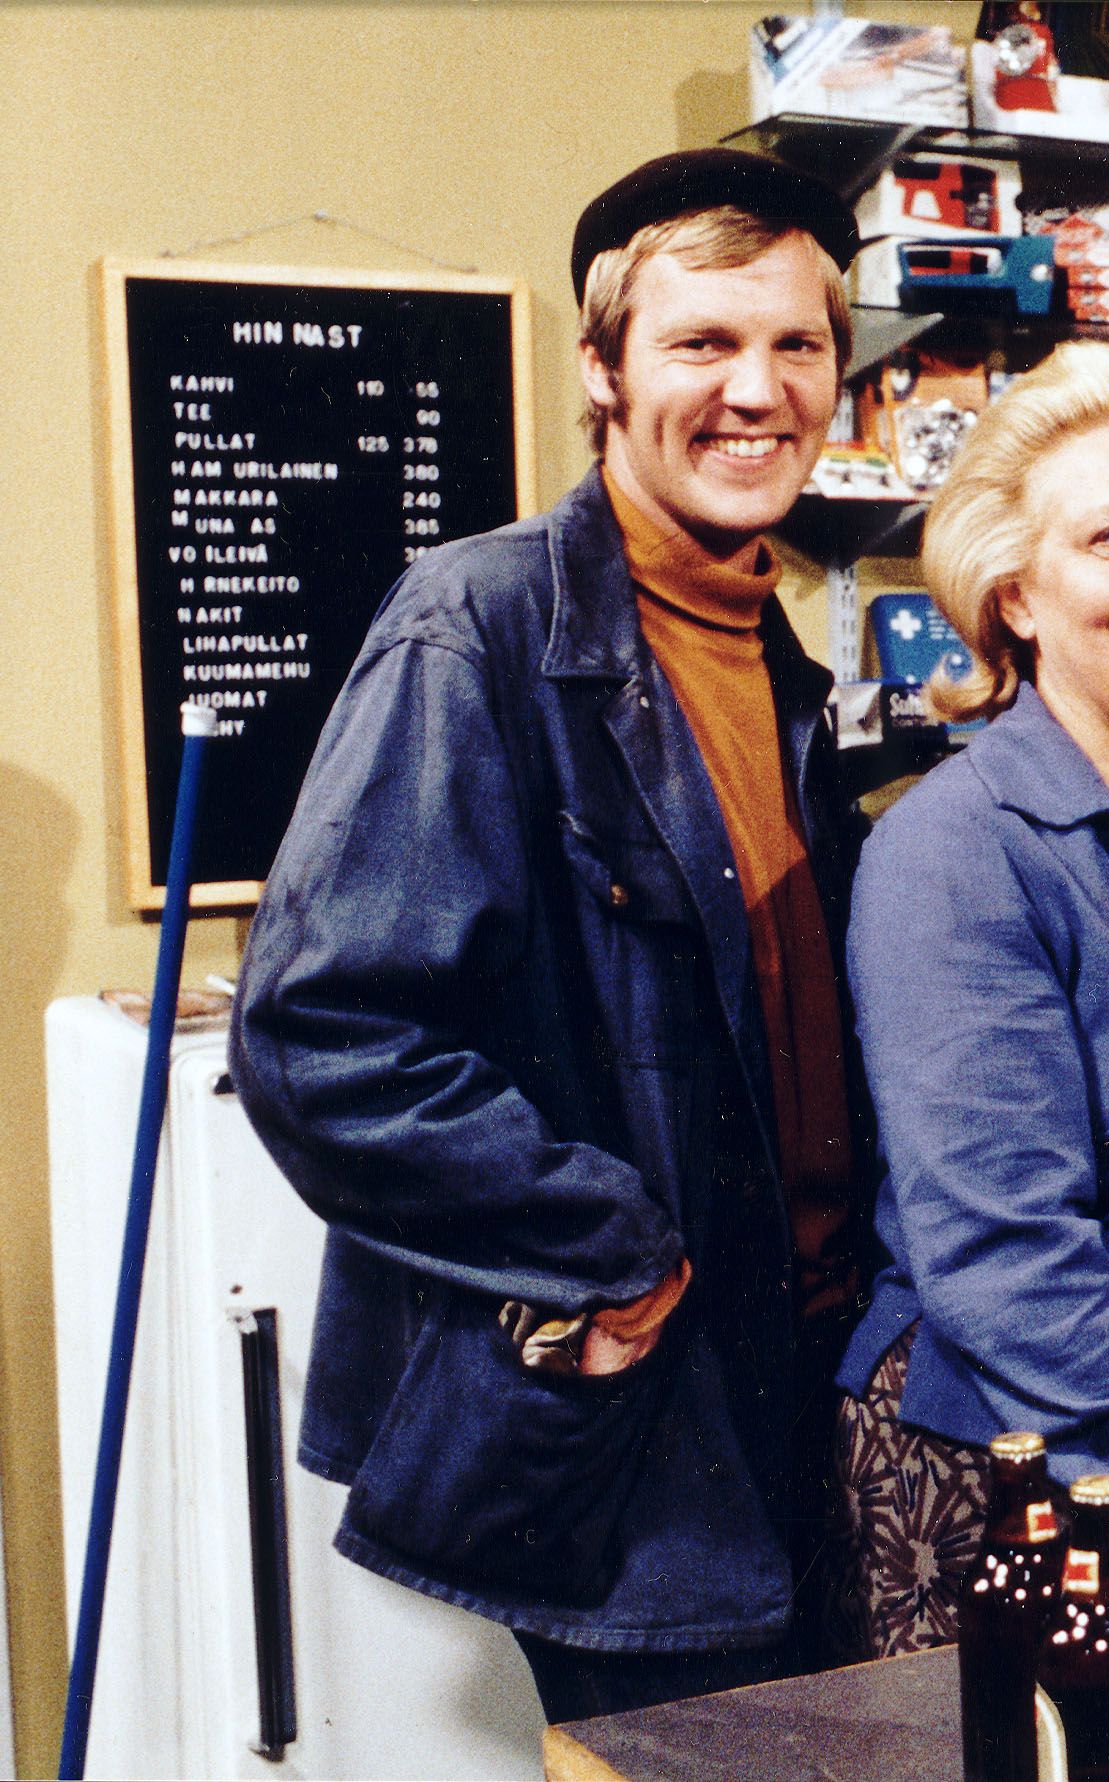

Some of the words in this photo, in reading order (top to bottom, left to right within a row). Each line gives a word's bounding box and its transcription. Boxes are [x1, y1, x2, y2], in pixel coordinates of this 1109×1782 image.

[170, 375, 234, 393] KAHVI
[173, 401, 212, 421] TEE
[175, 431, 256, 450] PULLAT
[402, 491, 441, 509] 240
[182, 633, 309, 654] LIHAPULLAT
[183, 661, 311, 682] KUUMAMEHU
